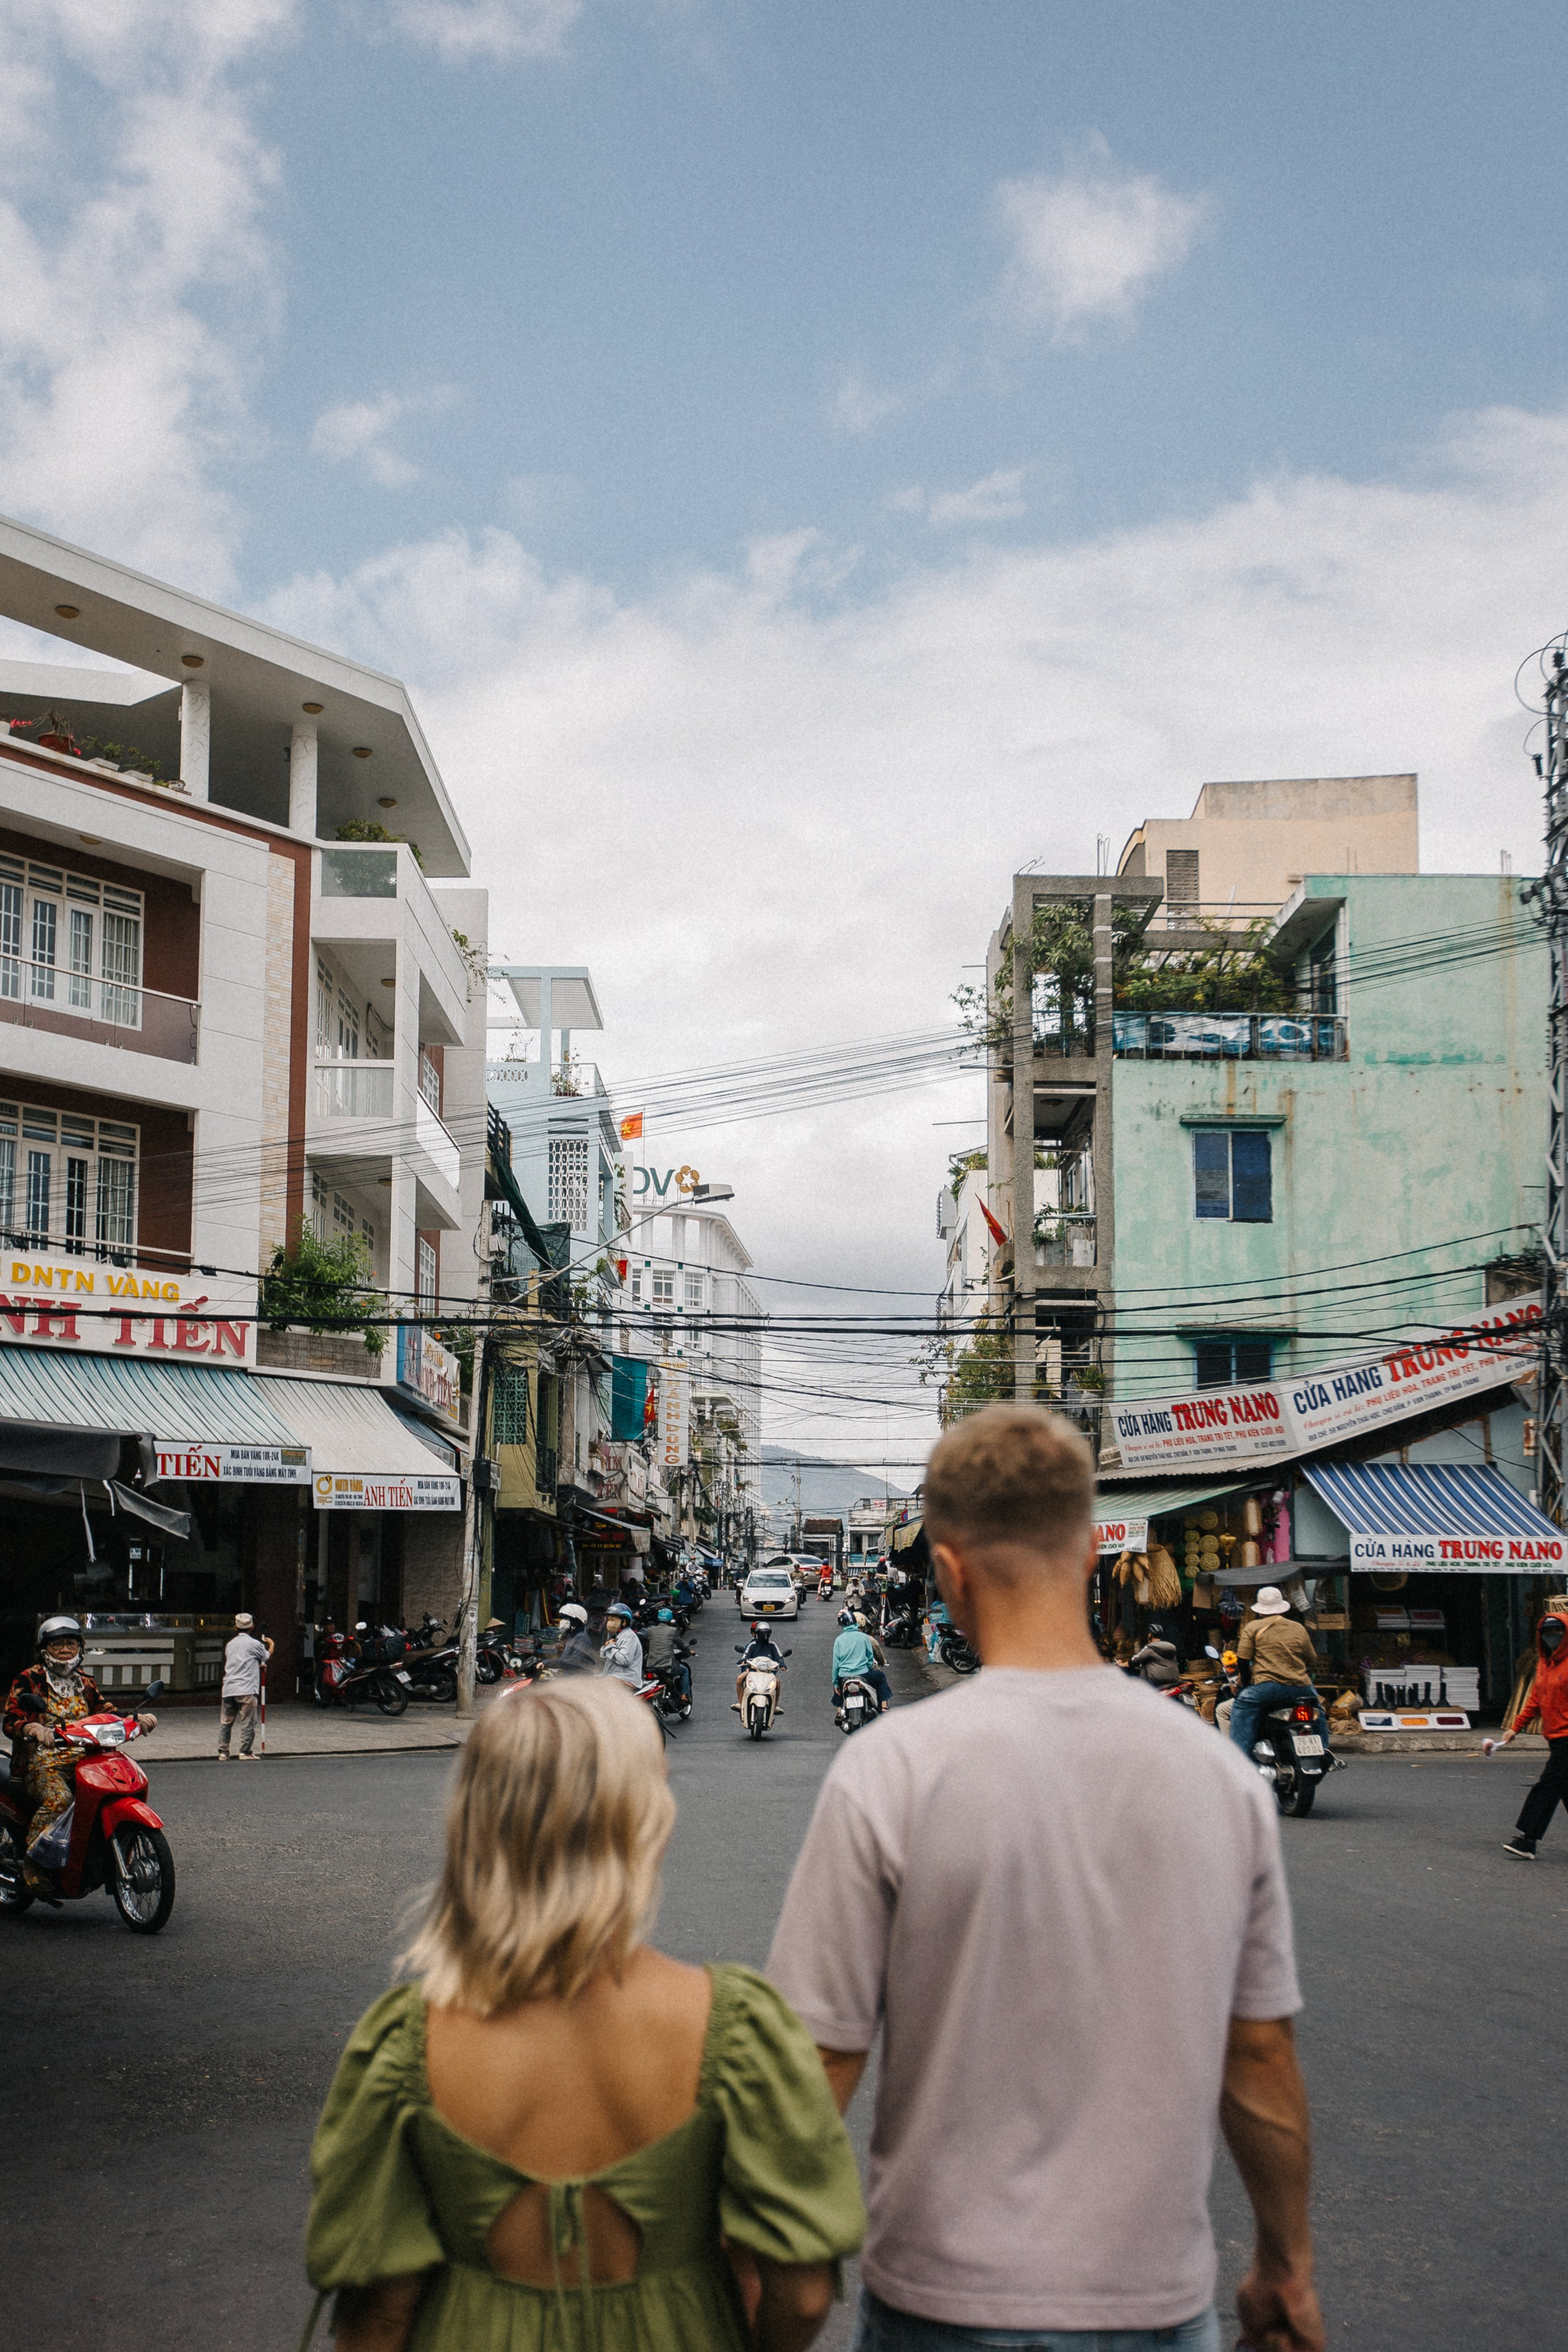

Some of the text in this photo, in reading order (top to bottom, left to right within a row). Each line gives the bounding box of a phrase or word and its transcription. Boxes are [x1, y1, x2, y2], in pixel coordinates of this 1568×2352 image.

[11, 1262, 180, 1302] DNTN VÀNG
[109, 1295, 250, 1357] TIẾN
[1293, 1381, 1332, 1414] CỬA
[1332, 1366, 1383, 1401] HÀNG
[1382, 1330, 1469, 1382] TRUNG
[665, 1370, 680, 1465] KHÁNH DŨNG
[1118, 1392, 1280, 1438] CỬA HÀNG TRUNG NANO
[1197, 1433, 1214, 1443] TRANG
[157, 1445, 222, 1477] TIẾN
[230, 1449, 240, 1460] MUA
[251, 1448, 262, 1460] VÀNG
[223, 1466, 232, 1476] XÁC
[233, 1466, 243, 1478] ĐỊNH
[253, 1466, 265, 1477] VÀNG
[266, 1466, 277, 1478] BẰNG
[278, 1466, 287, 1478] MÁY
[363, 1477, 413, 1507] ANH TIẾN
[1091, 1523, 1126, 1542] ANO
[1355, 1538, 1563, 1560] CỬA HÀNG TRUNG NANO
